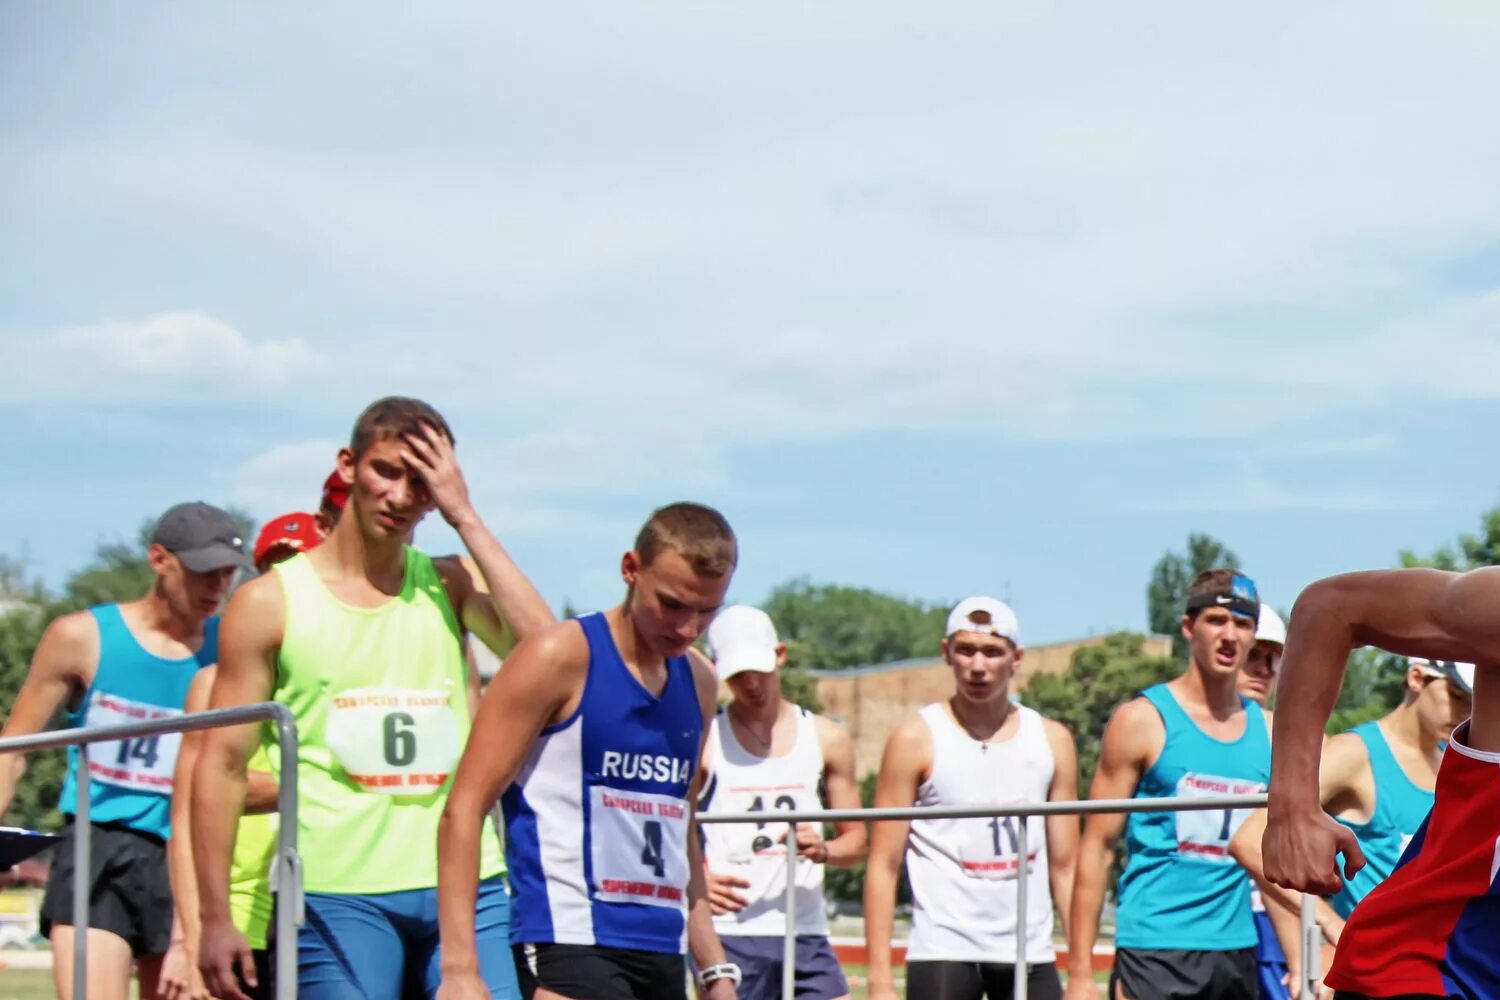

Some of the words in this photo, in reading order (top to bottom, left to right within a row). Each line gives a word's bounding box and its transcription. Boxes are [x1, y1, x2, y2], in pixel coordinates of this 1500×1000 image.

[117, 734, 160, 768] 14
[383, 711, 416, 767] 6
[602, 751, 690, 784] RUSSIA
[641, 820, 665, 878] 4
